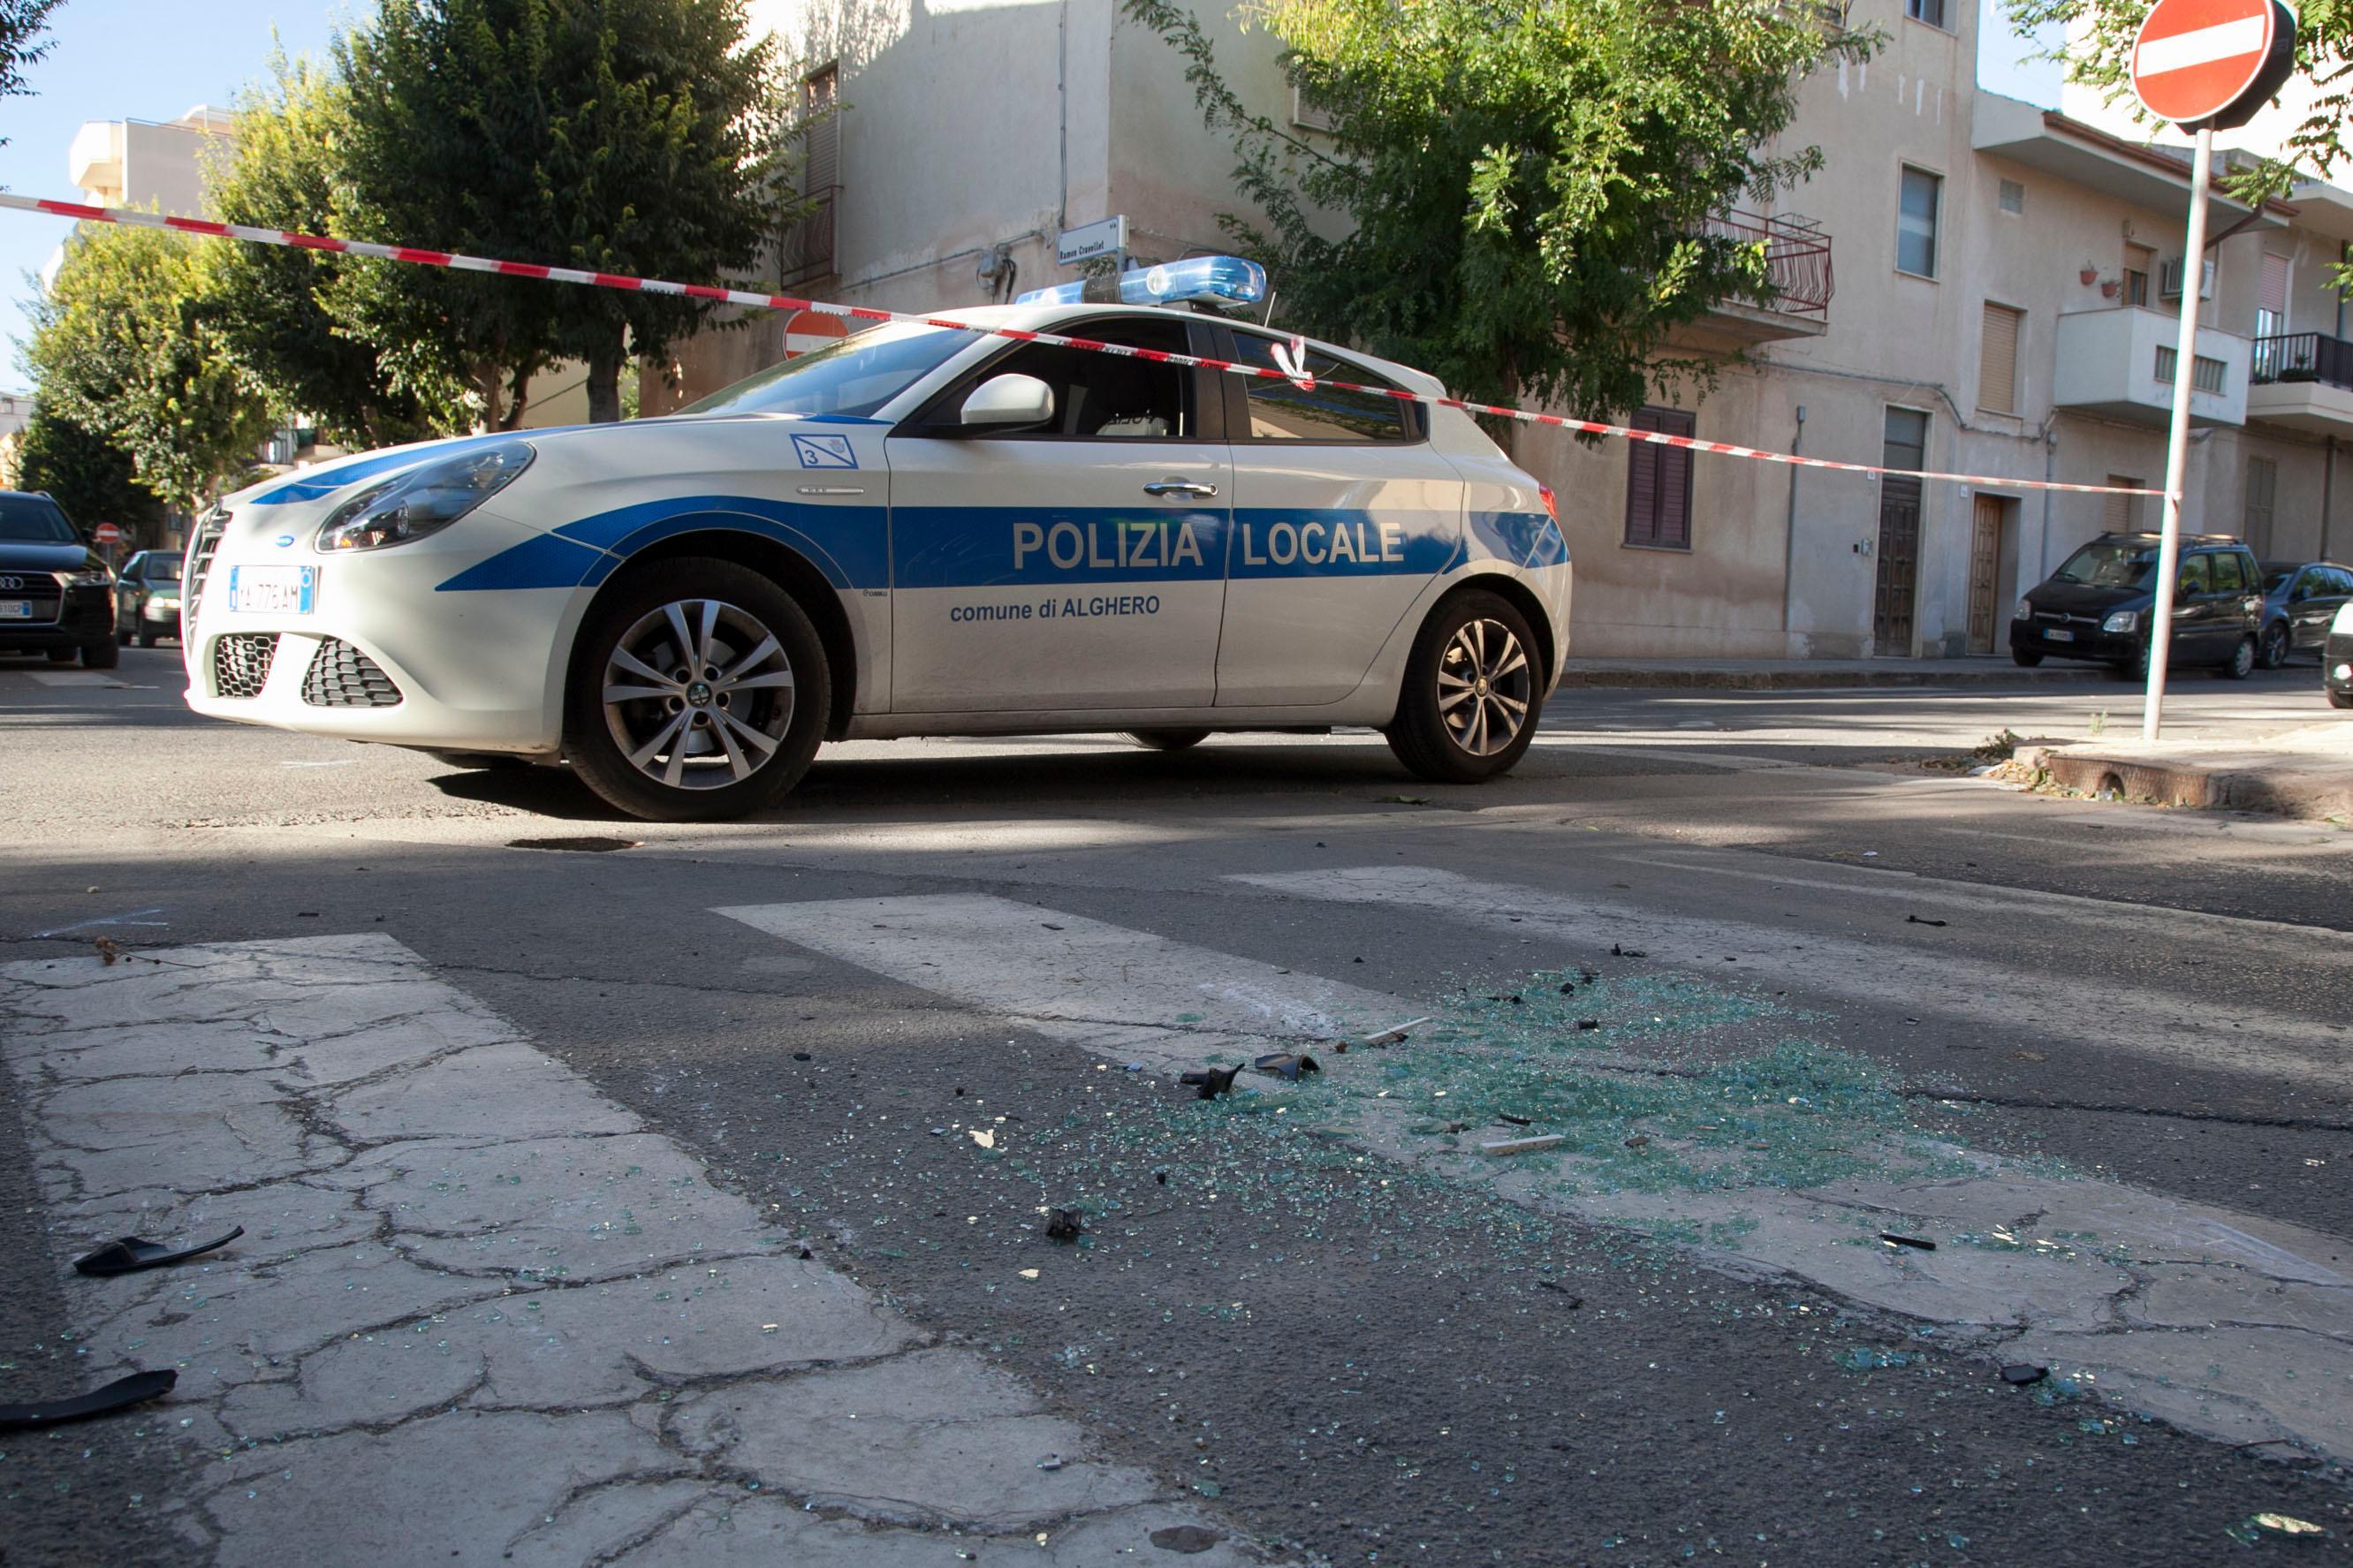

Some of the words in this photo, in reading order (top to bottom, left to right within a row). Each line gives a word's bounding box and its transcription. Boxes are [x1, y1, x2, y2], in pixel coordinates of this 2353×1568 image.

[1060, 250, 1076, 260] Ramon
[804, 449, 819, 465] 3
[1013, 522, 1204, 570] POLIZIA
[1242, 522, 1405, 566] LOCALE
[950, 604, 1033, 622] comune
[1038, 599, 1057, 618] di
[1061, 595, 1161, 617] ALGHERO
